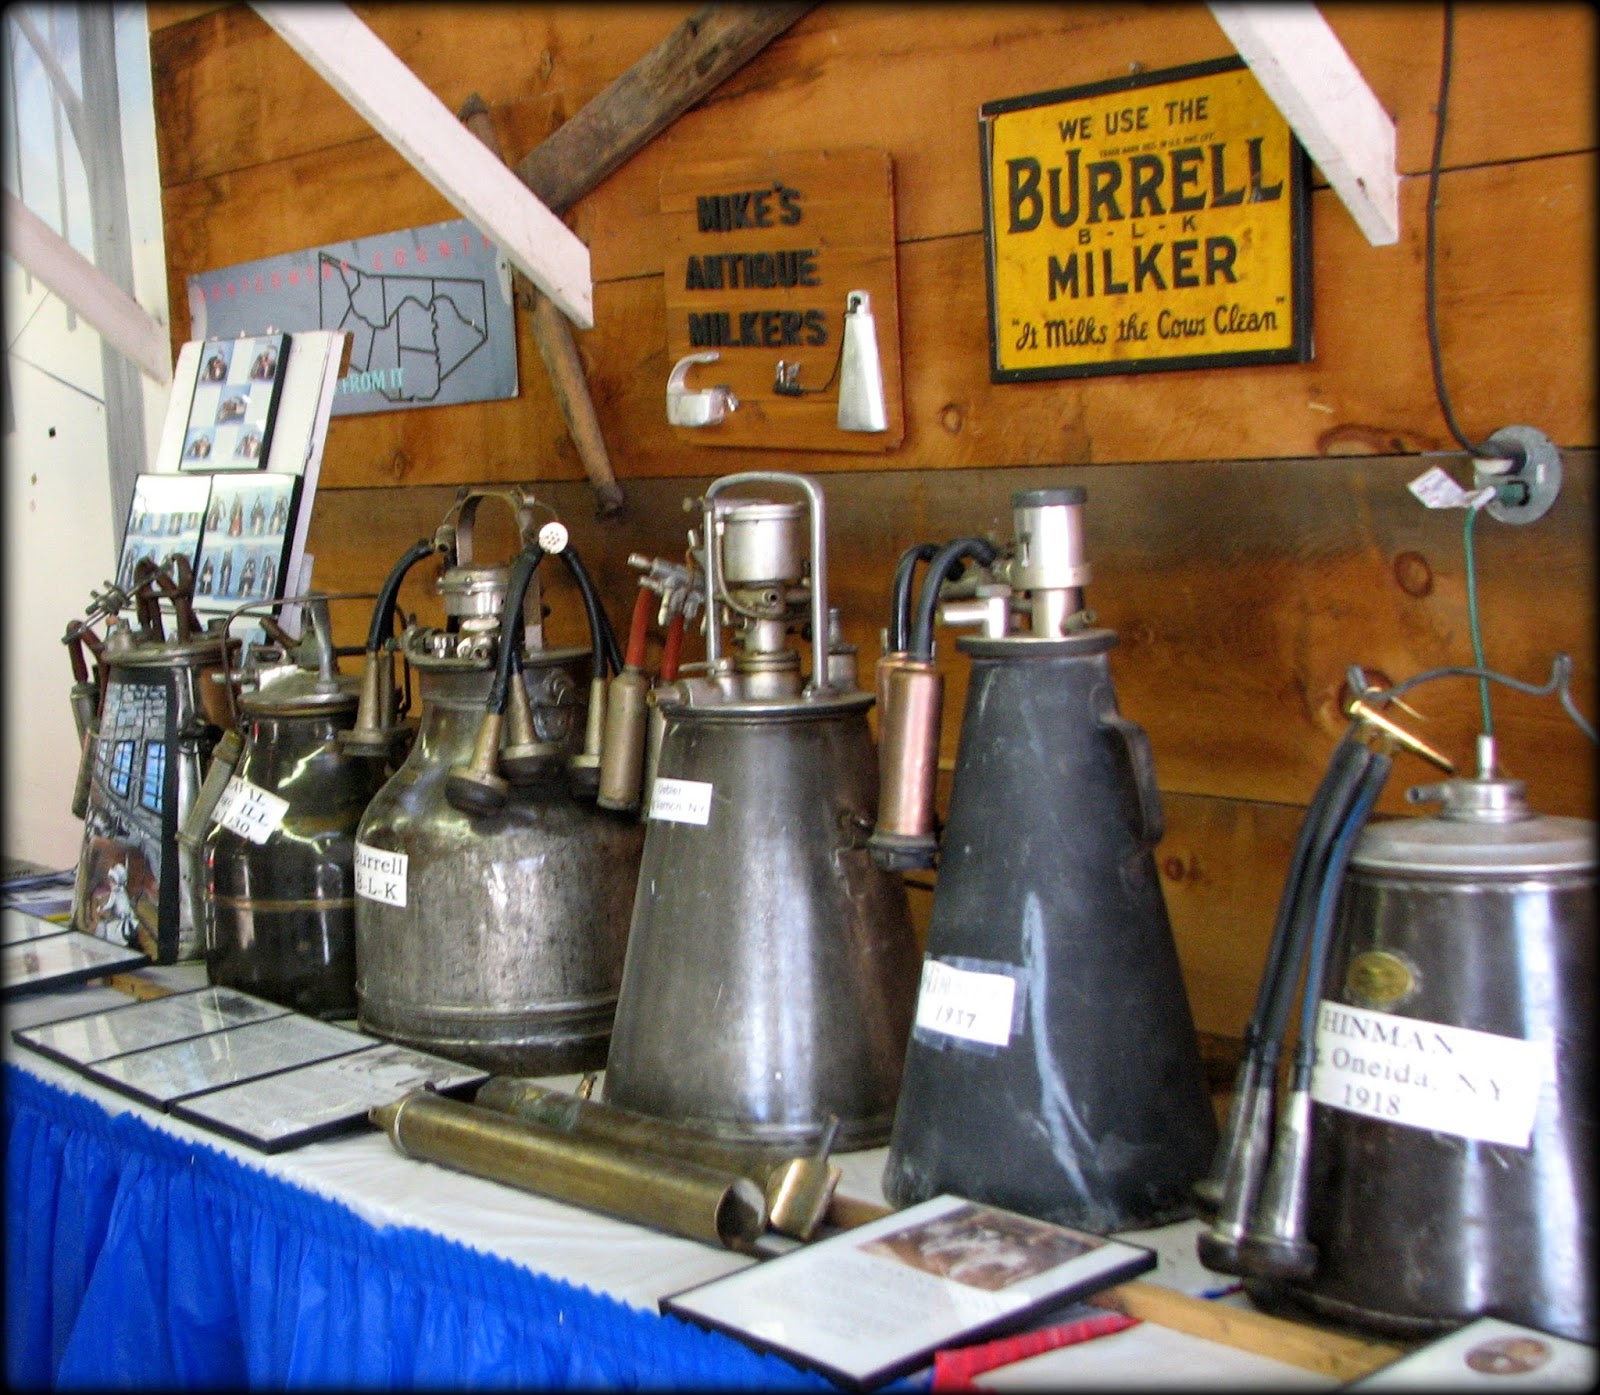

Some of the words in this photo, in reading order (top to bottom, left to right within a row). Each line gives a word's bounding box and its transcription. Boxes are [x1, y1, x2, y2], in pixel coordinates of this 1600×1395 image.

[1058, 116, 1092, 143] WE
[1105, 105, 1150, 135] USE
[1165, 95, 1209, 125] THE
[696, 182, 803, 232] MIKE'S
[1004, 136, 1284, 235] BURRELL
[685, 249, 822, 290] ANTIQUE
[1048, 235, 1238, 302] MILKER
[687, 309, 830, 348] MILKERS
[1044, 316, 1108, 348] Milks
[1116, 312, 1149, 341] the
[1157, 308, 1206, 340] Cows
[390, 367, 405, 389] IT
[1322, 1006, 1456, 1055] HINMAN
[1343, 1083, 1401, 1116] 1918
